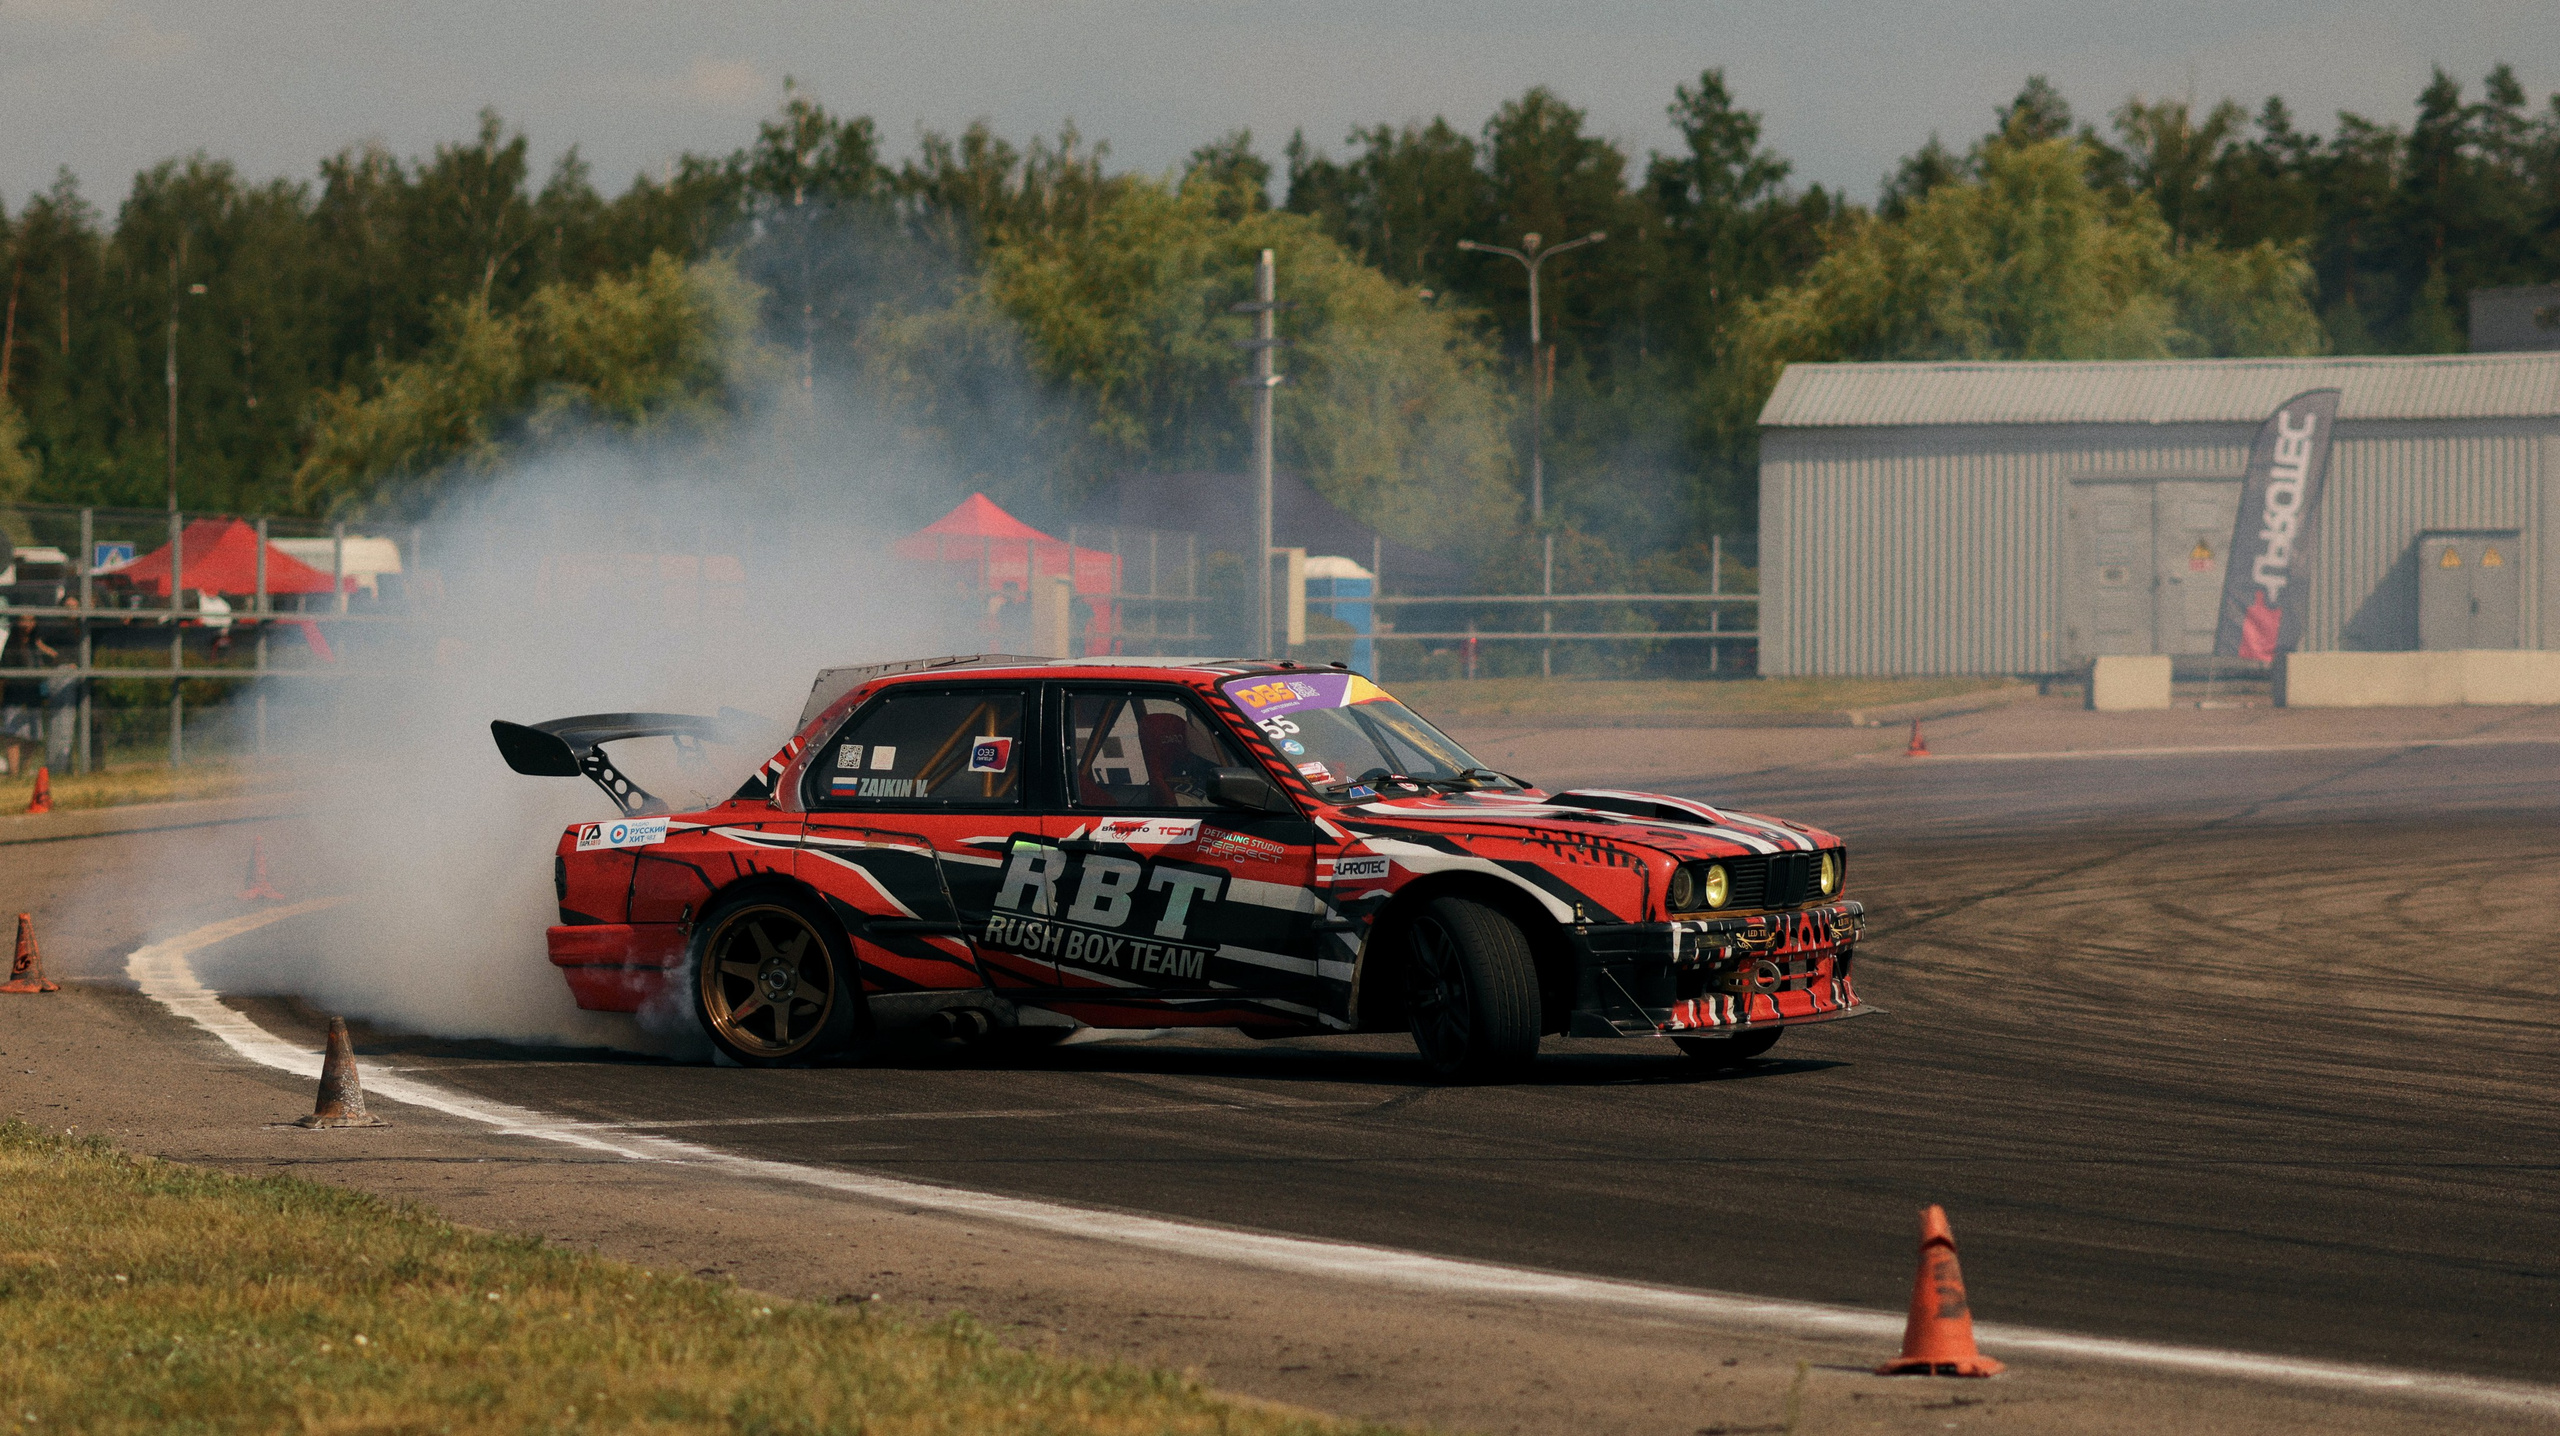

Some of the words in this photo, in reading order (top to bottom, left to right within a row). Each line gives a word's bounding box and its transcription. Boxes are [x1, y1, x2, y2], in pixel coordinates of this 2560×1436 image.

[1235, 682, 1296, 708] DBS
[1256, 714, 1300, 739] 55
[977, 748, 995, 757] ОЭЗ
[858, 778, 913, 797] ZAIKIN
[915, 779, 929, 798] V.
[629, 835, 645, 843] ХИТ
[630, 826, 666, 835] РУССКИЙ
[1203, 828, 1250, 845] DETAILING
[1250, 836, 1285, 854] STUDIO
[1196, 845, 1246, 864] AUTO
[1199, 837, 1283, 865] PERFECT
[993, 840, 1223, 940] RBT
[984, 914, 1065, 956] RUSH
[1065, 930, 1125, 967] BOX
[1129, 941, 1206, 980] TEAM
